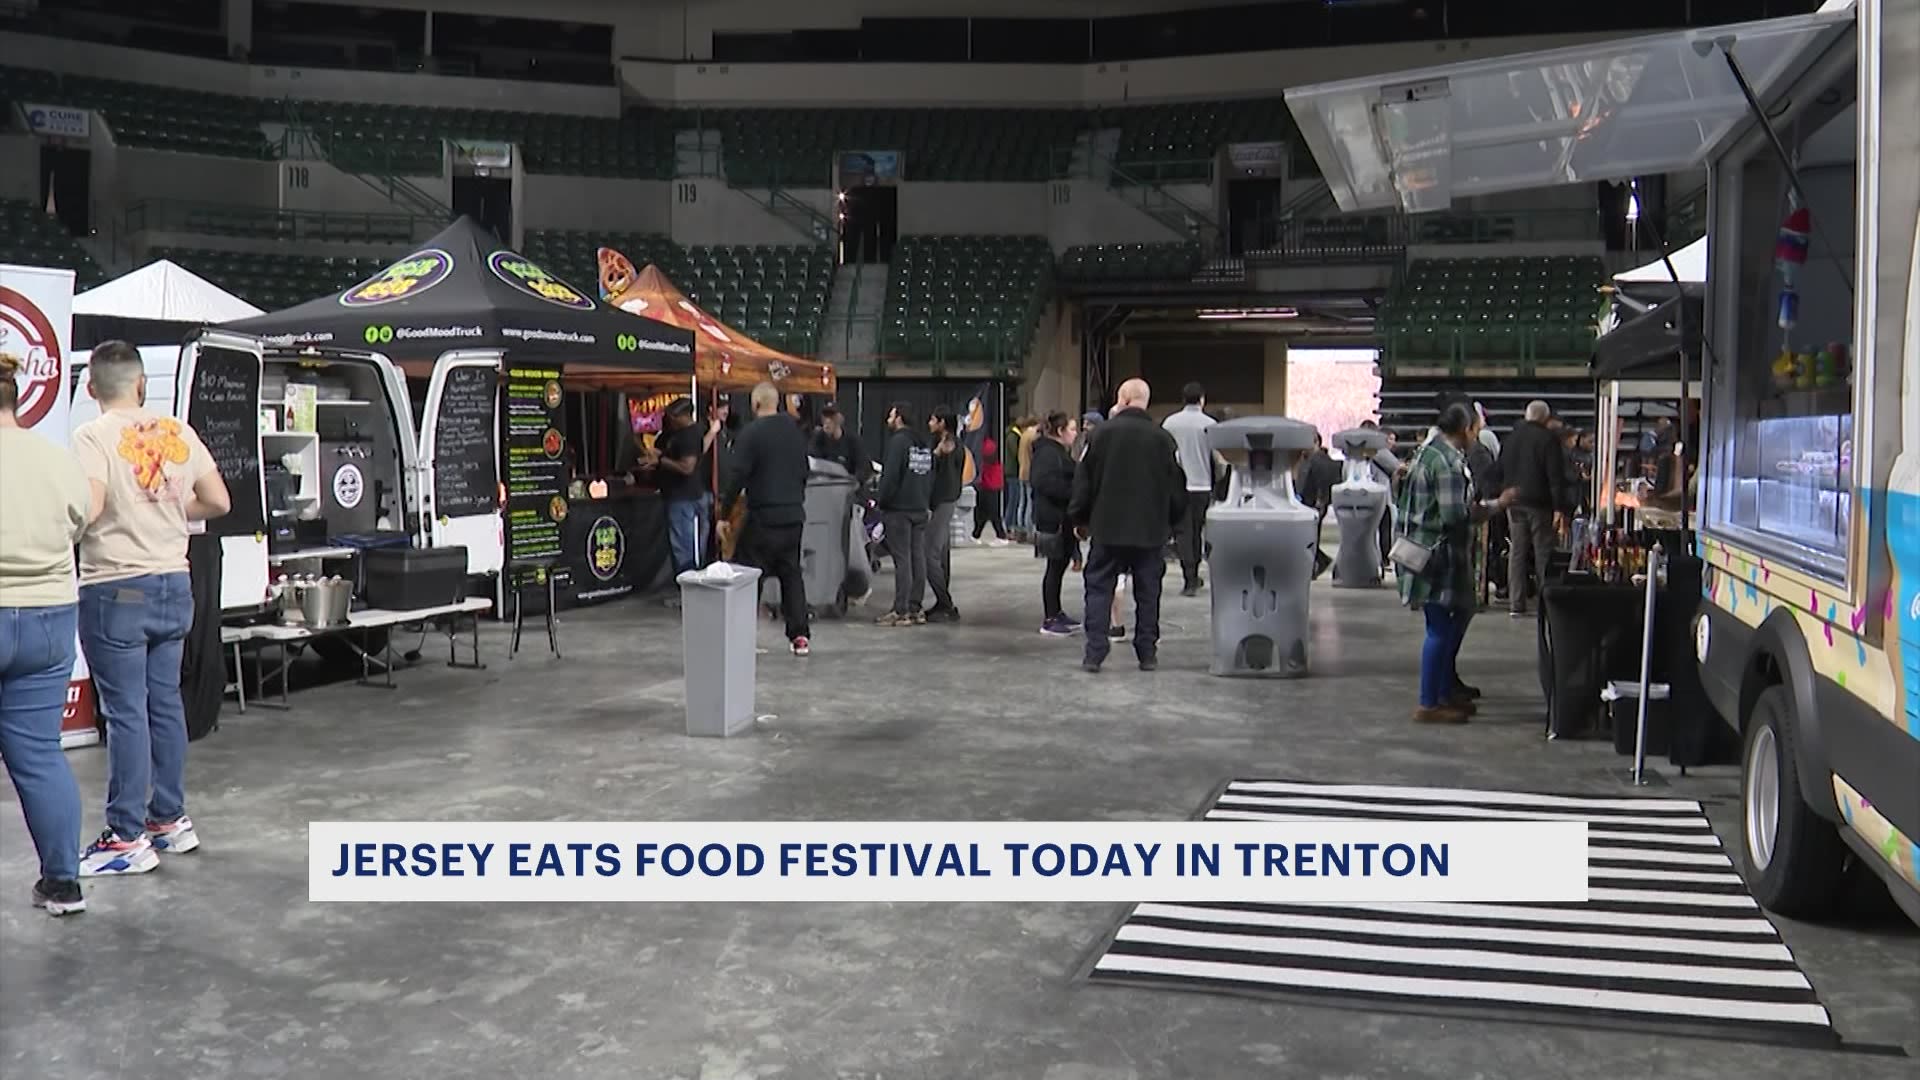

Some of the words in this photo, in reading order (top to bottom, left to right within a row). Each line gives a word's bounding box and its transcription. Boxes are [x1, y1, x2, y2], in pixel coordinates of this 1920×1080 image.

[288, 165, 309, 189] 118
[678, 183, 697, 204] 119
[396, 325, 483, 340] @GoodMoodTruck
